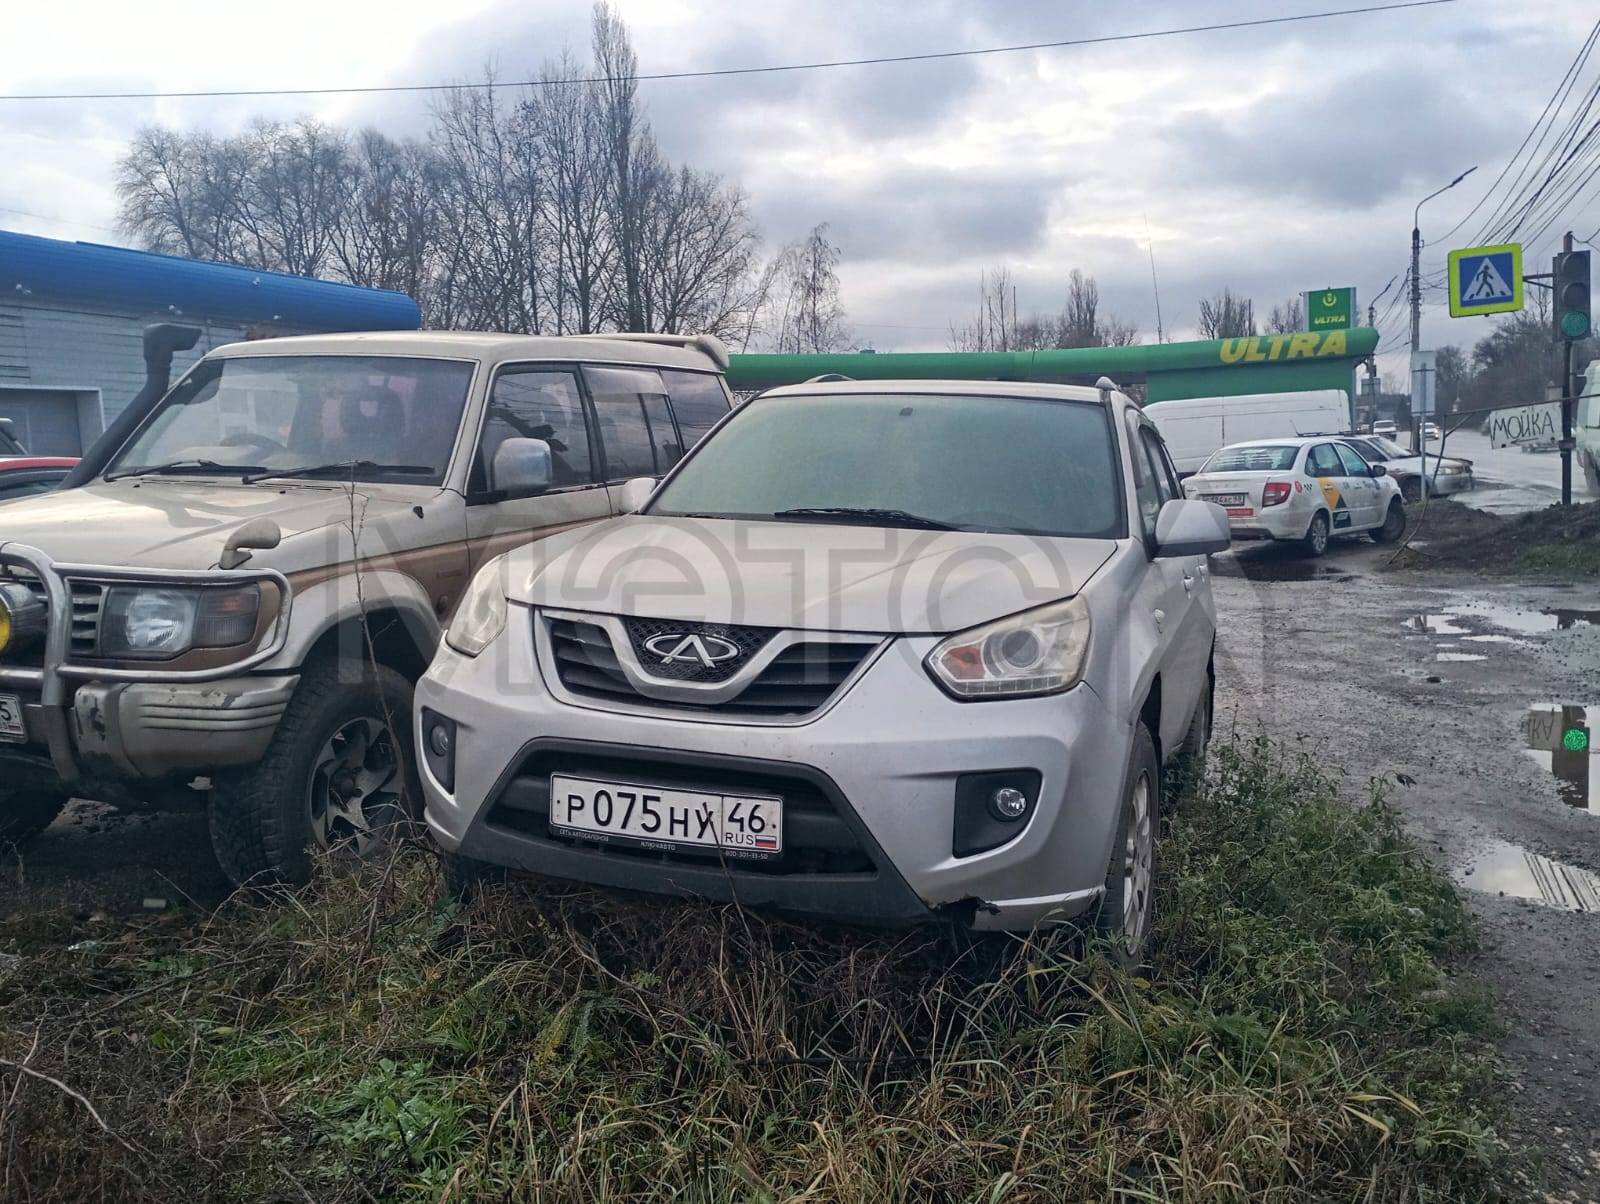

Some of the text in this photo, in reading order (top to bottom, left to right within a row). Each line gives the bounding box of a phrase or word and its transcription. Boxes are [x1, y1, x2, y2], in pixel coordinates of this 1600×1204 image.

[1314, 314, 1346, 325] ULTRA
[1219, 329, 1347, 364] ULTRA
[1493, 408, 1555, 441] МОЙКА
[567, 789, 714, 839] Р075НУ
[727, 802, 765, 833] 46
[725, 832, 754, 845] RUS
